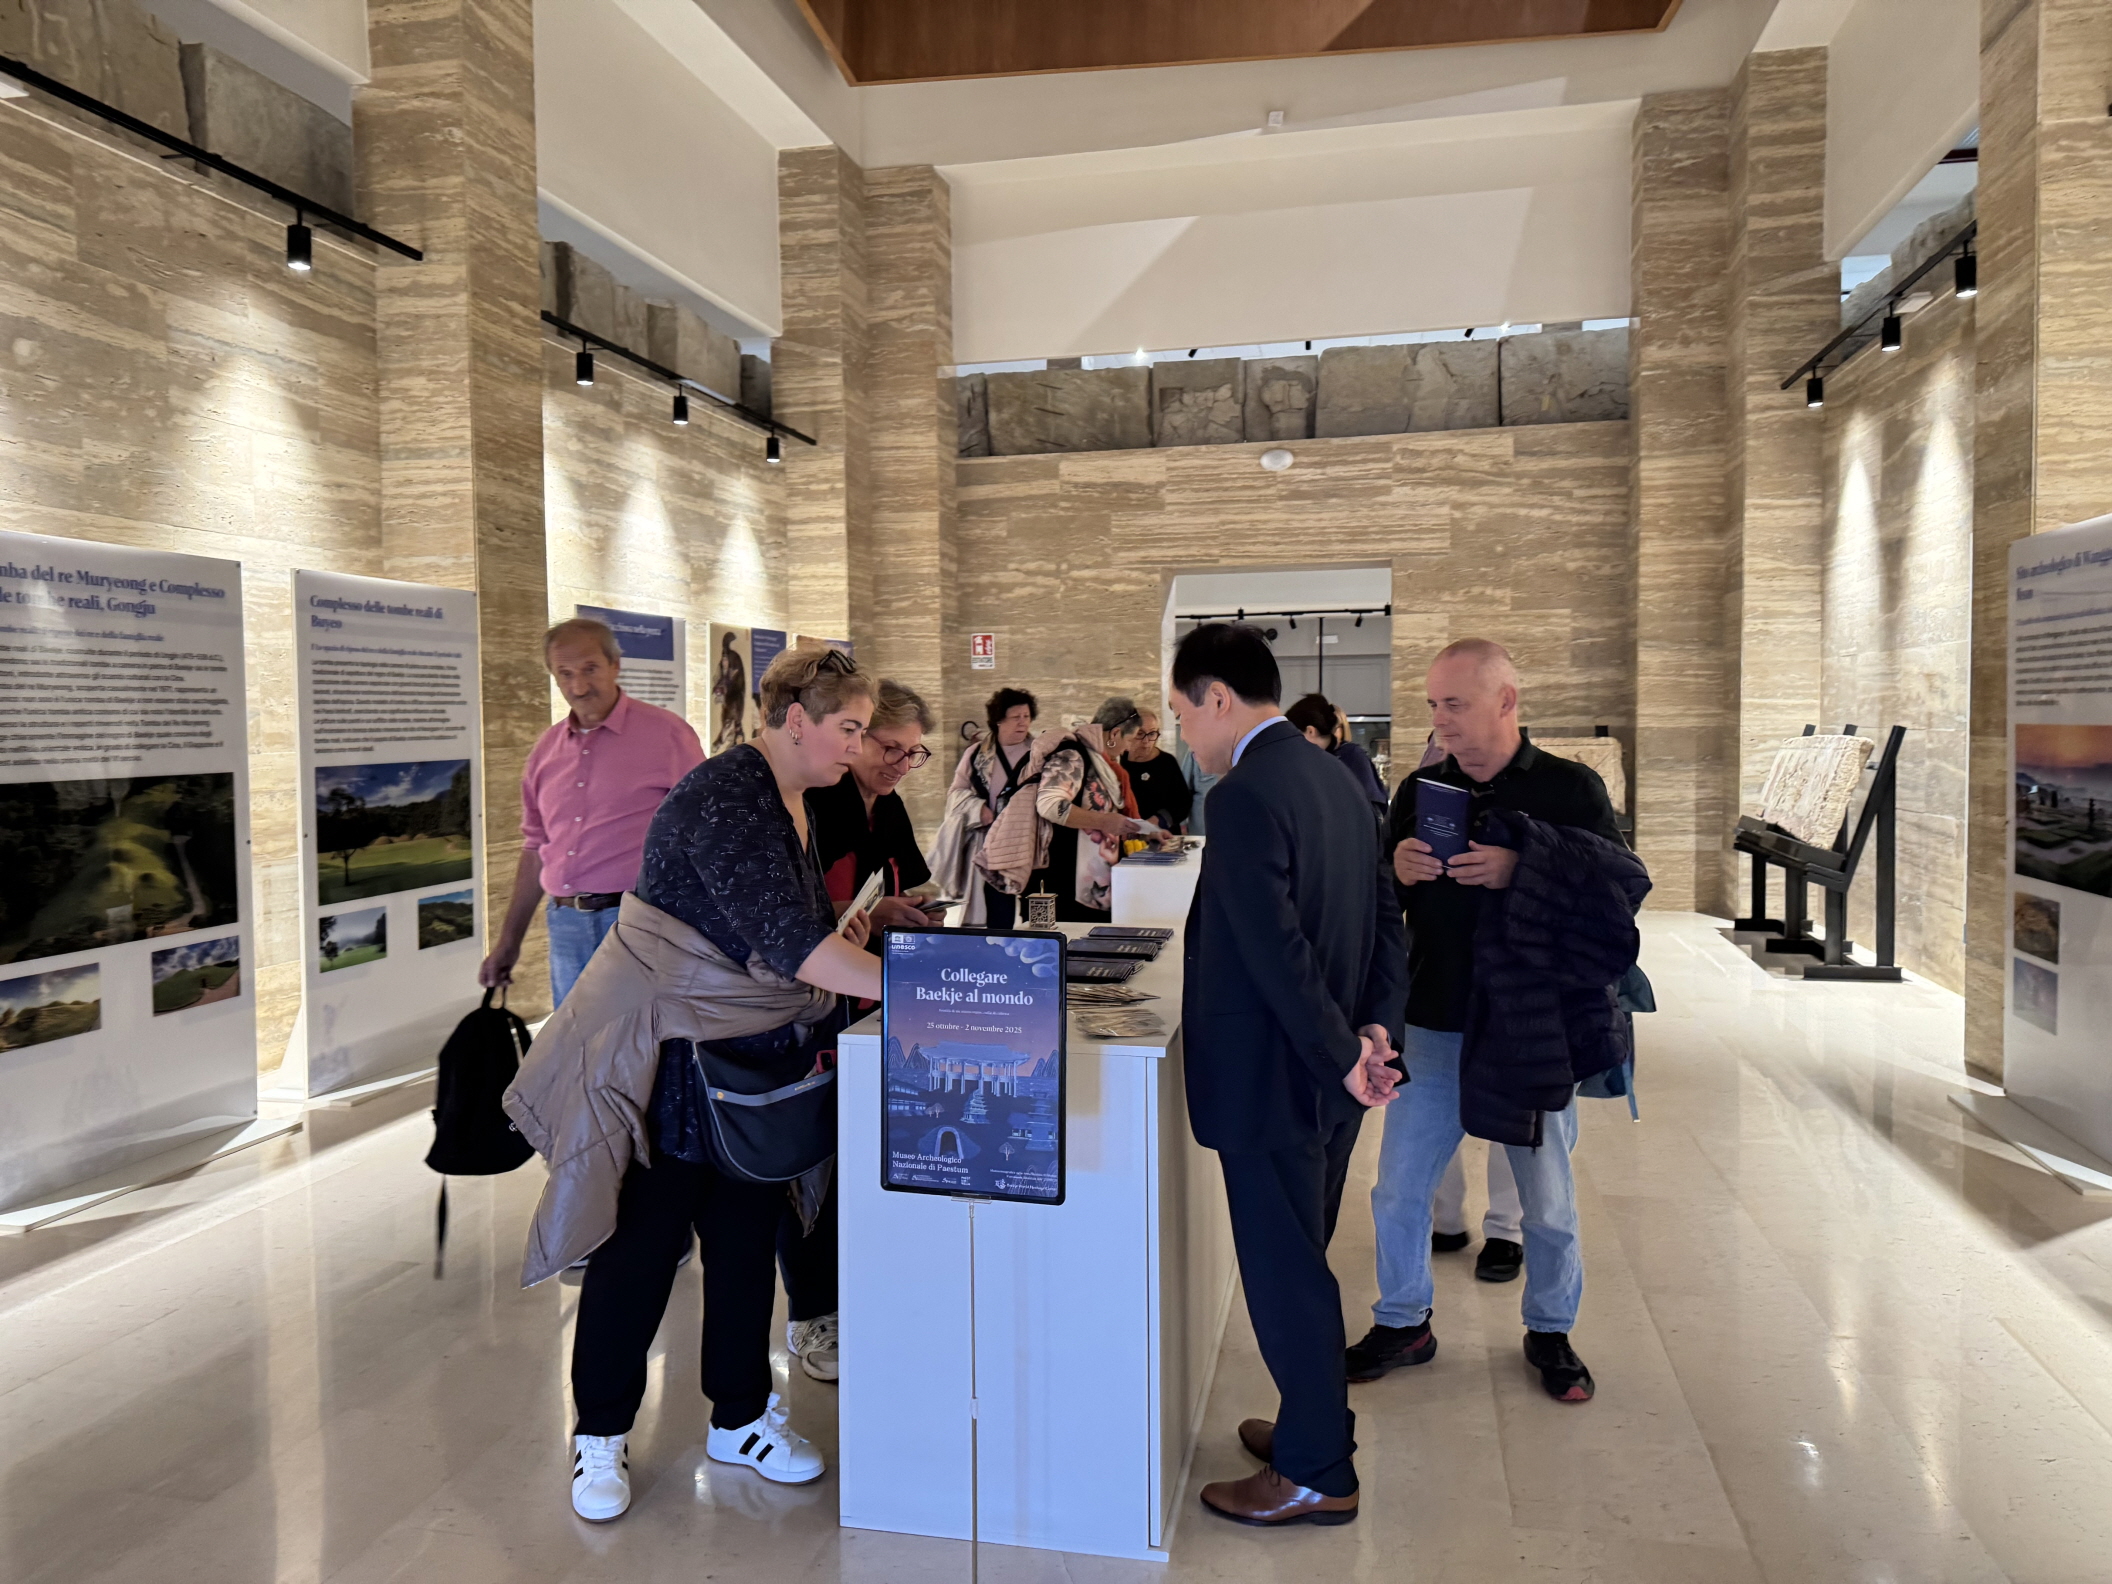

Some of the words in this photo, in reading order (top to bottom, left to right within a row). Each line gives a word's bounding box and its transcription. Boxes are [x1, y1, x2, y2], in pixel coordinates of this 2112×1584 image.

[31, 565, 54, 581] del
[58, 572, 73, 583] re
[76, 570, 147, 595] Muryeong
[149, 582, 157, 592] e
[159, 579, 225, 600] Complesso
[107, 597, 156, 618] Gongju
[941, 968, 1008, 987] Collegare
[916, 987, 963, 1006] Baekje
[966, 989, 979, 1004] al
[982, 991, 1033, 1006] mondo
[970, 1025, 1004, 1033] novembre
[1004, 1026, 1022, 1034] 2025
[892, 1151, 916, 1160] Museo
[917, 1153, 962, 1164] Archeologico
[892, 1160, 927, 1170] Nazionale
[928, 1163, 936, 1171] di
[937, 1164, 969, 1174] Paestum
